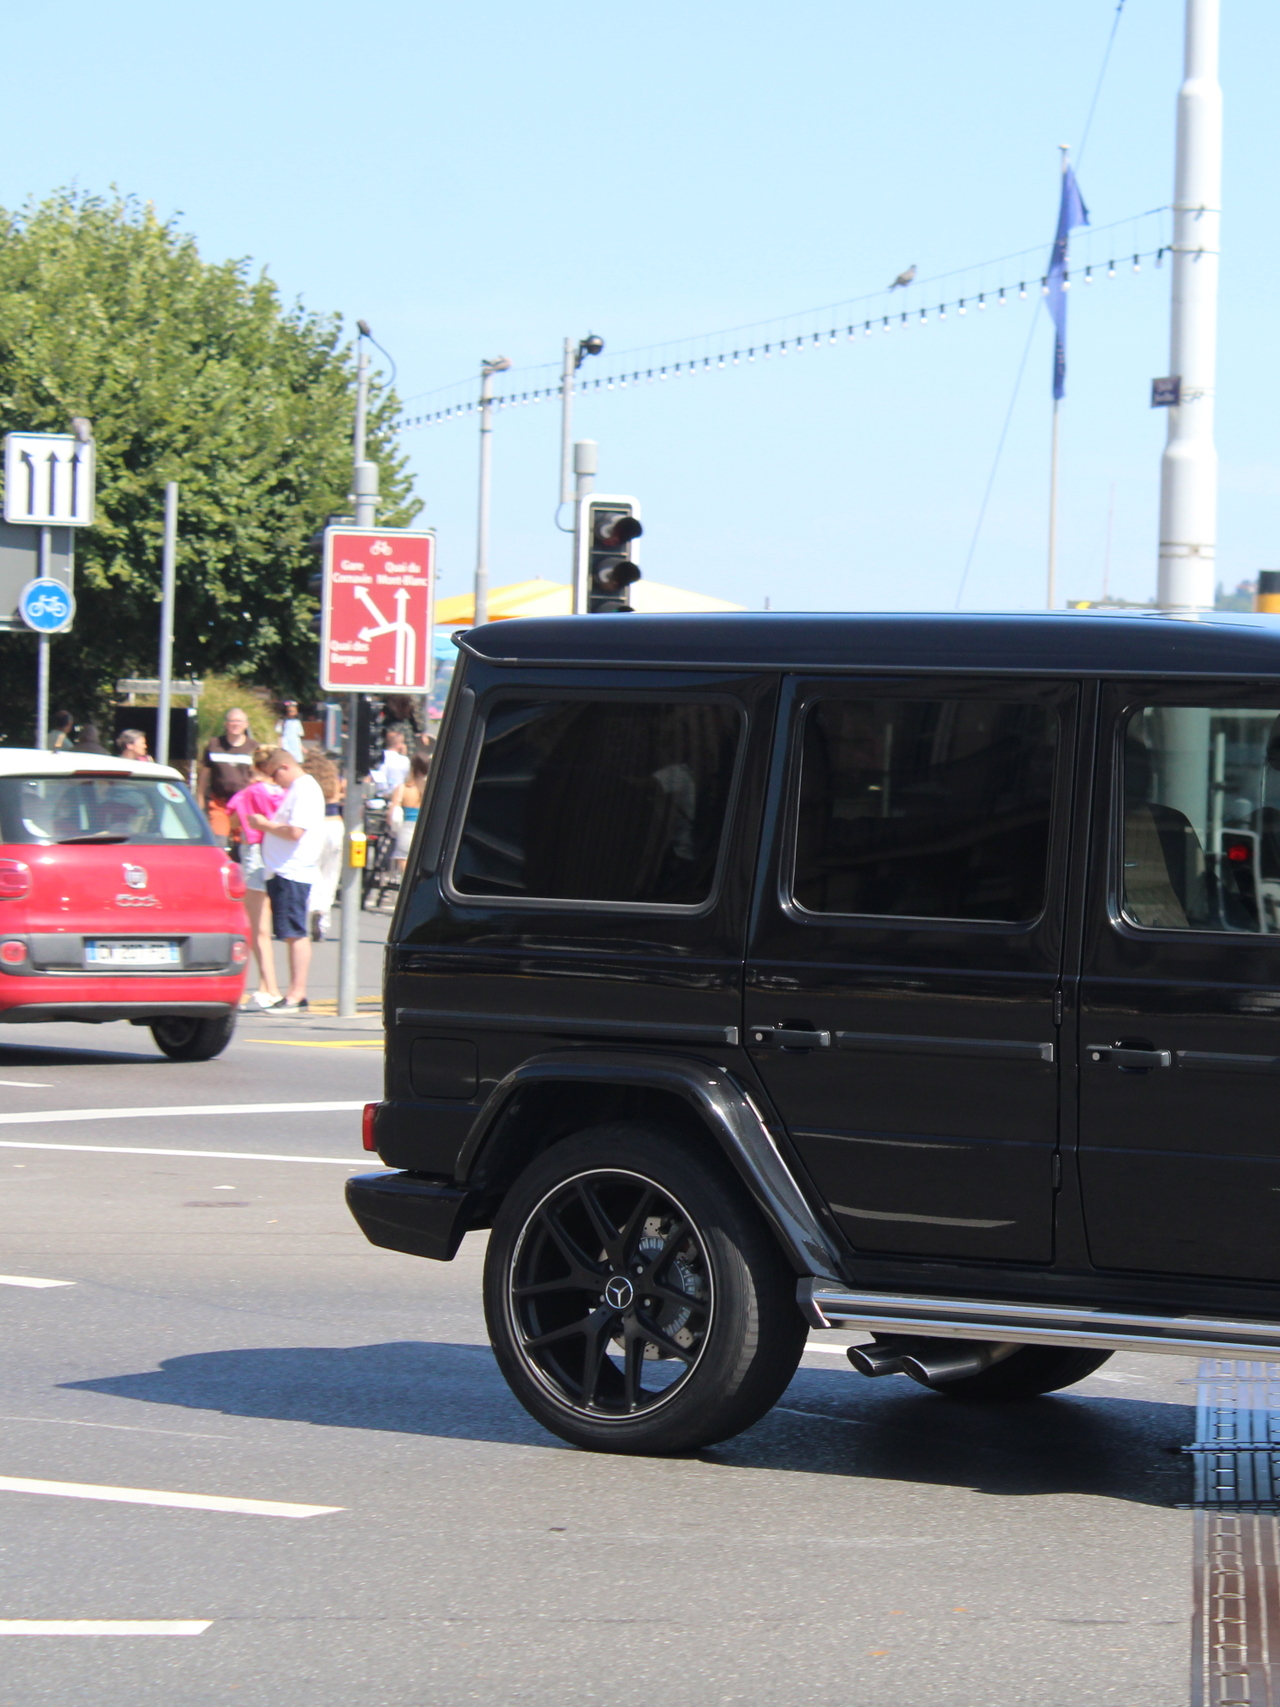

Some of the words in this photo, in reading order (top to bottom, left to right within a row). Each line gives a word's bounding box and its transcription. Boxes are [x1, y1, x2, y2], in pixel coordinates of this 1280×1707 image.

[340, 560, 364, 571] Gare
[384, 561, 405, 573] Quai
[407, 562, 421, 573] du
[376, 574, 428, 586] Mont-Blanc
[330, 640, 351, 652] Quai
[353, 641, 370, 652] des
[330, 653, 368, 667] Bergues
